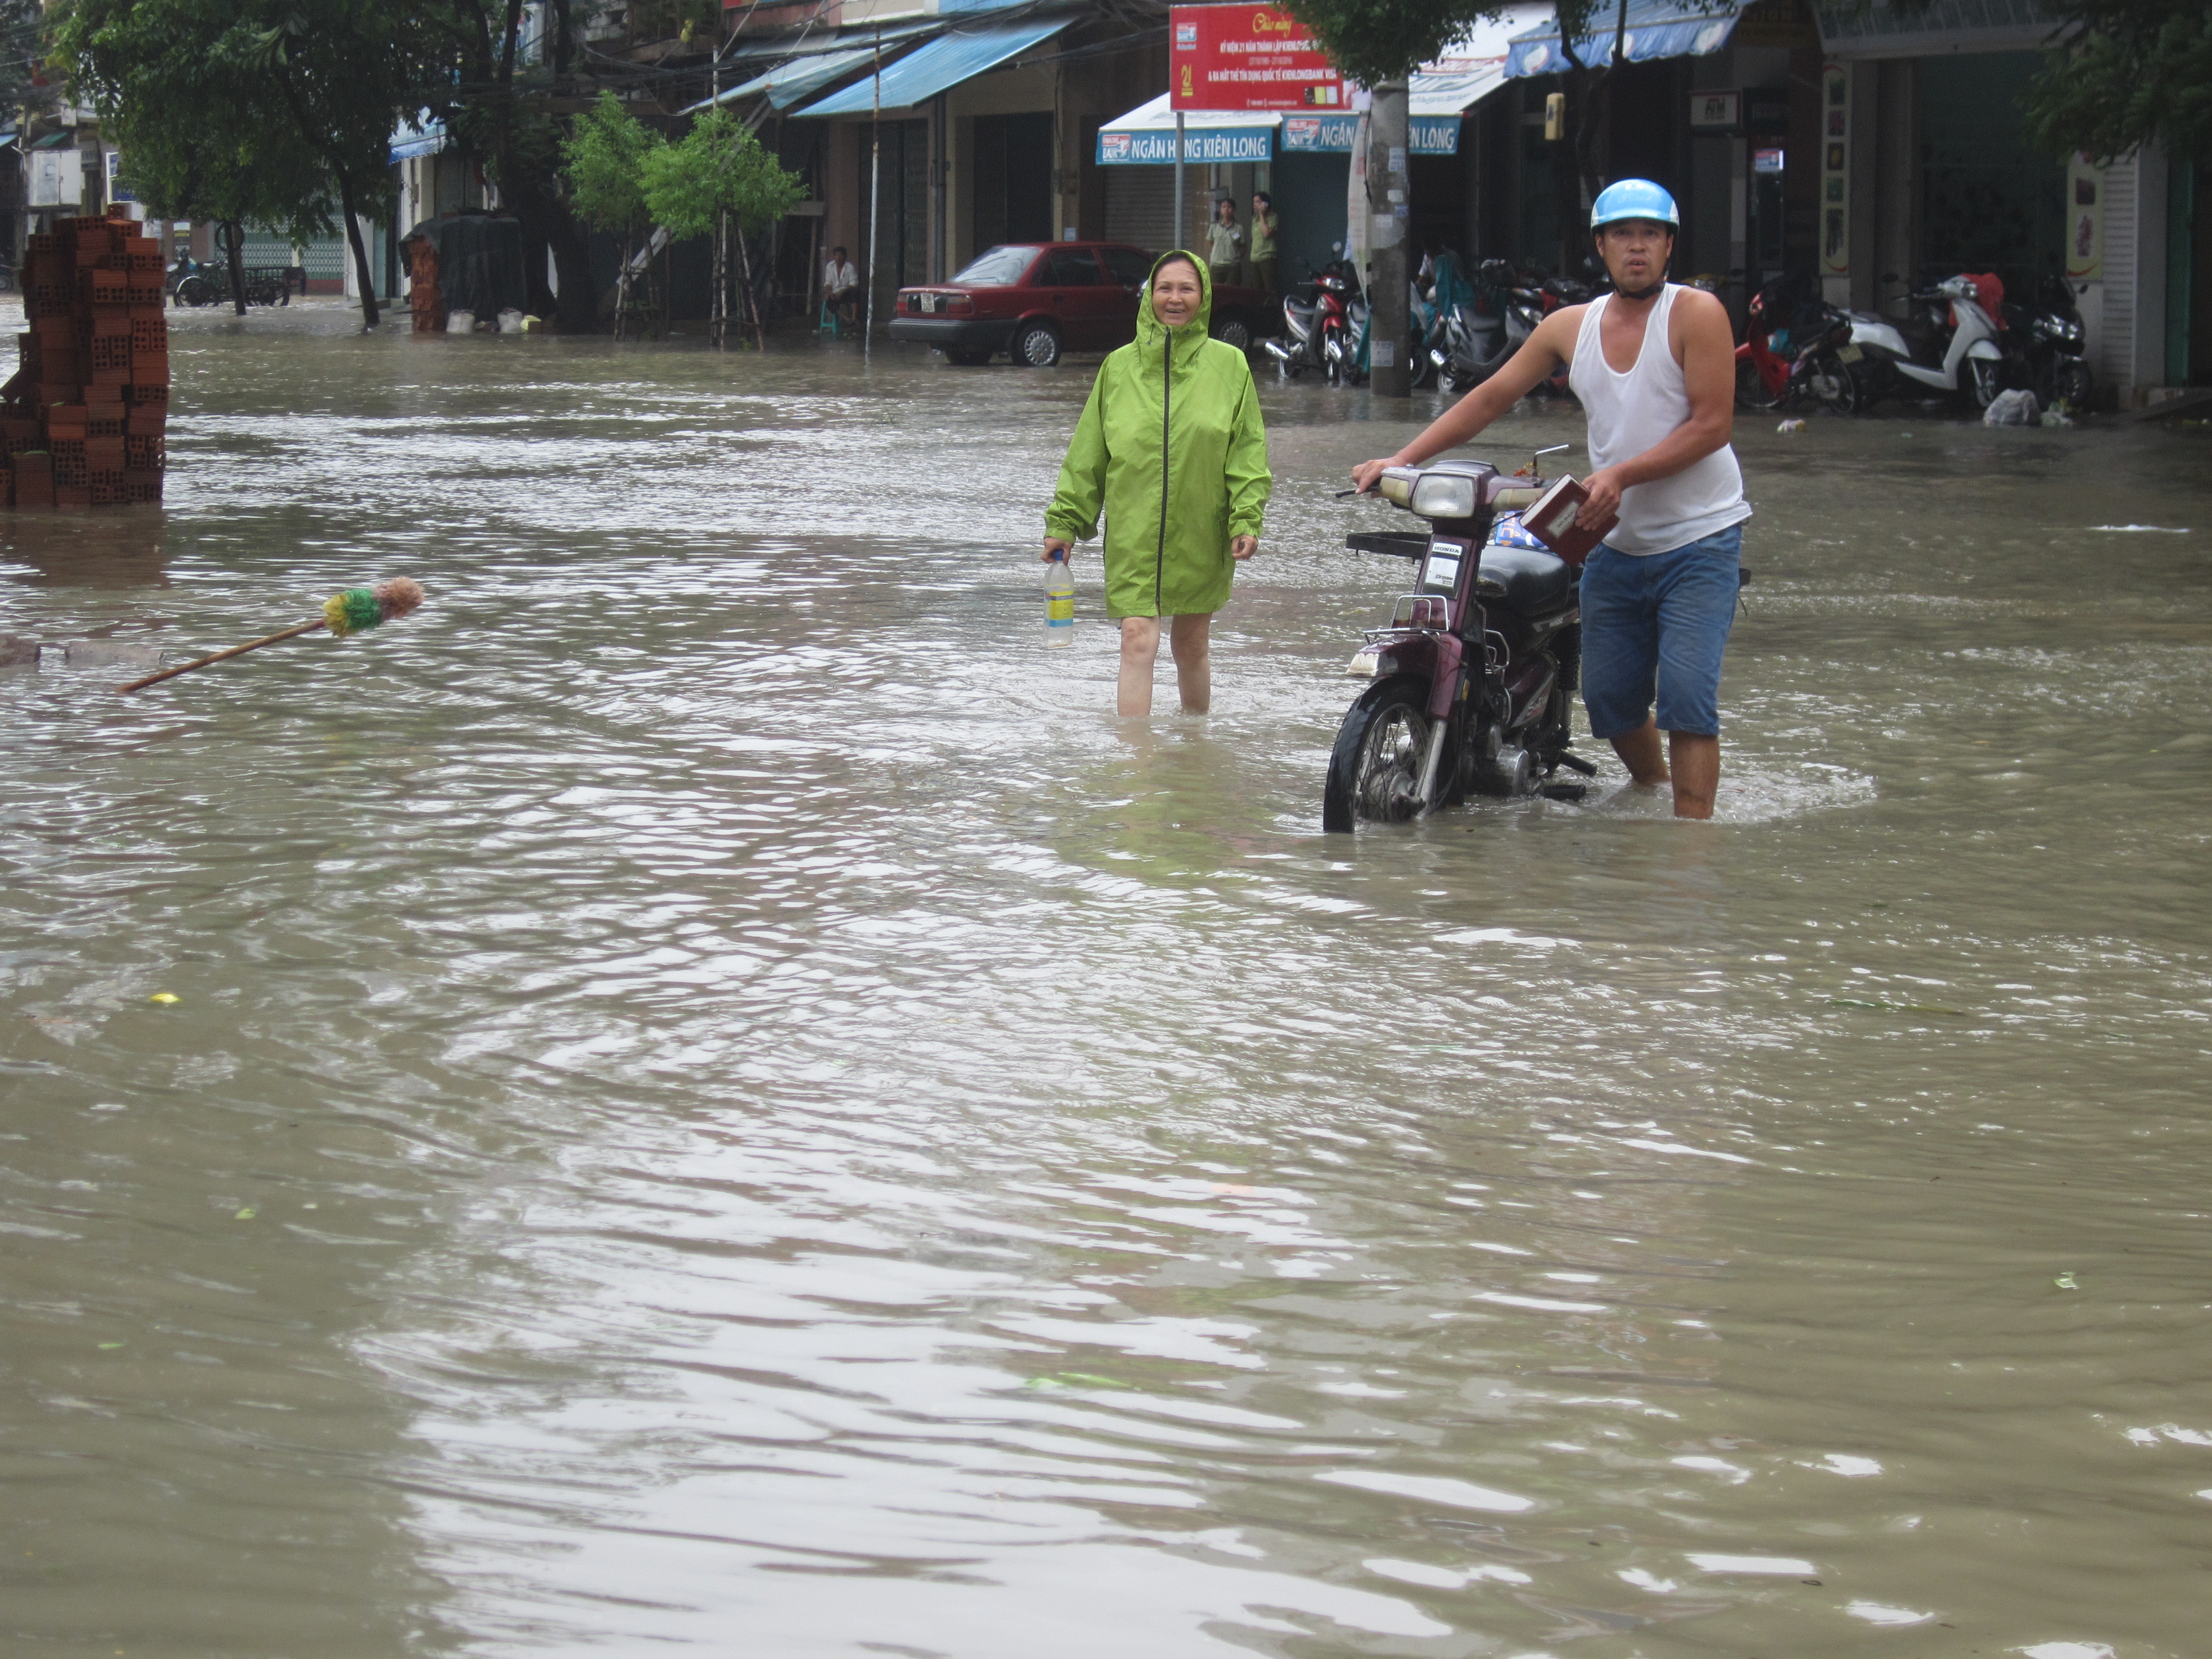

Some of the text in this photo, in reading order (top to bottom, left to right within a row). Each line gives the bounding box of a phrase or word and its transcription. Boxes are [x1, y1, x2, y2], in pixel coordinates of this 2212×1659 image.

[1131, 134, 1266, 159] NGÂN HNG KIÊN LONG
[1422, 127, 1455, 149] LONG
